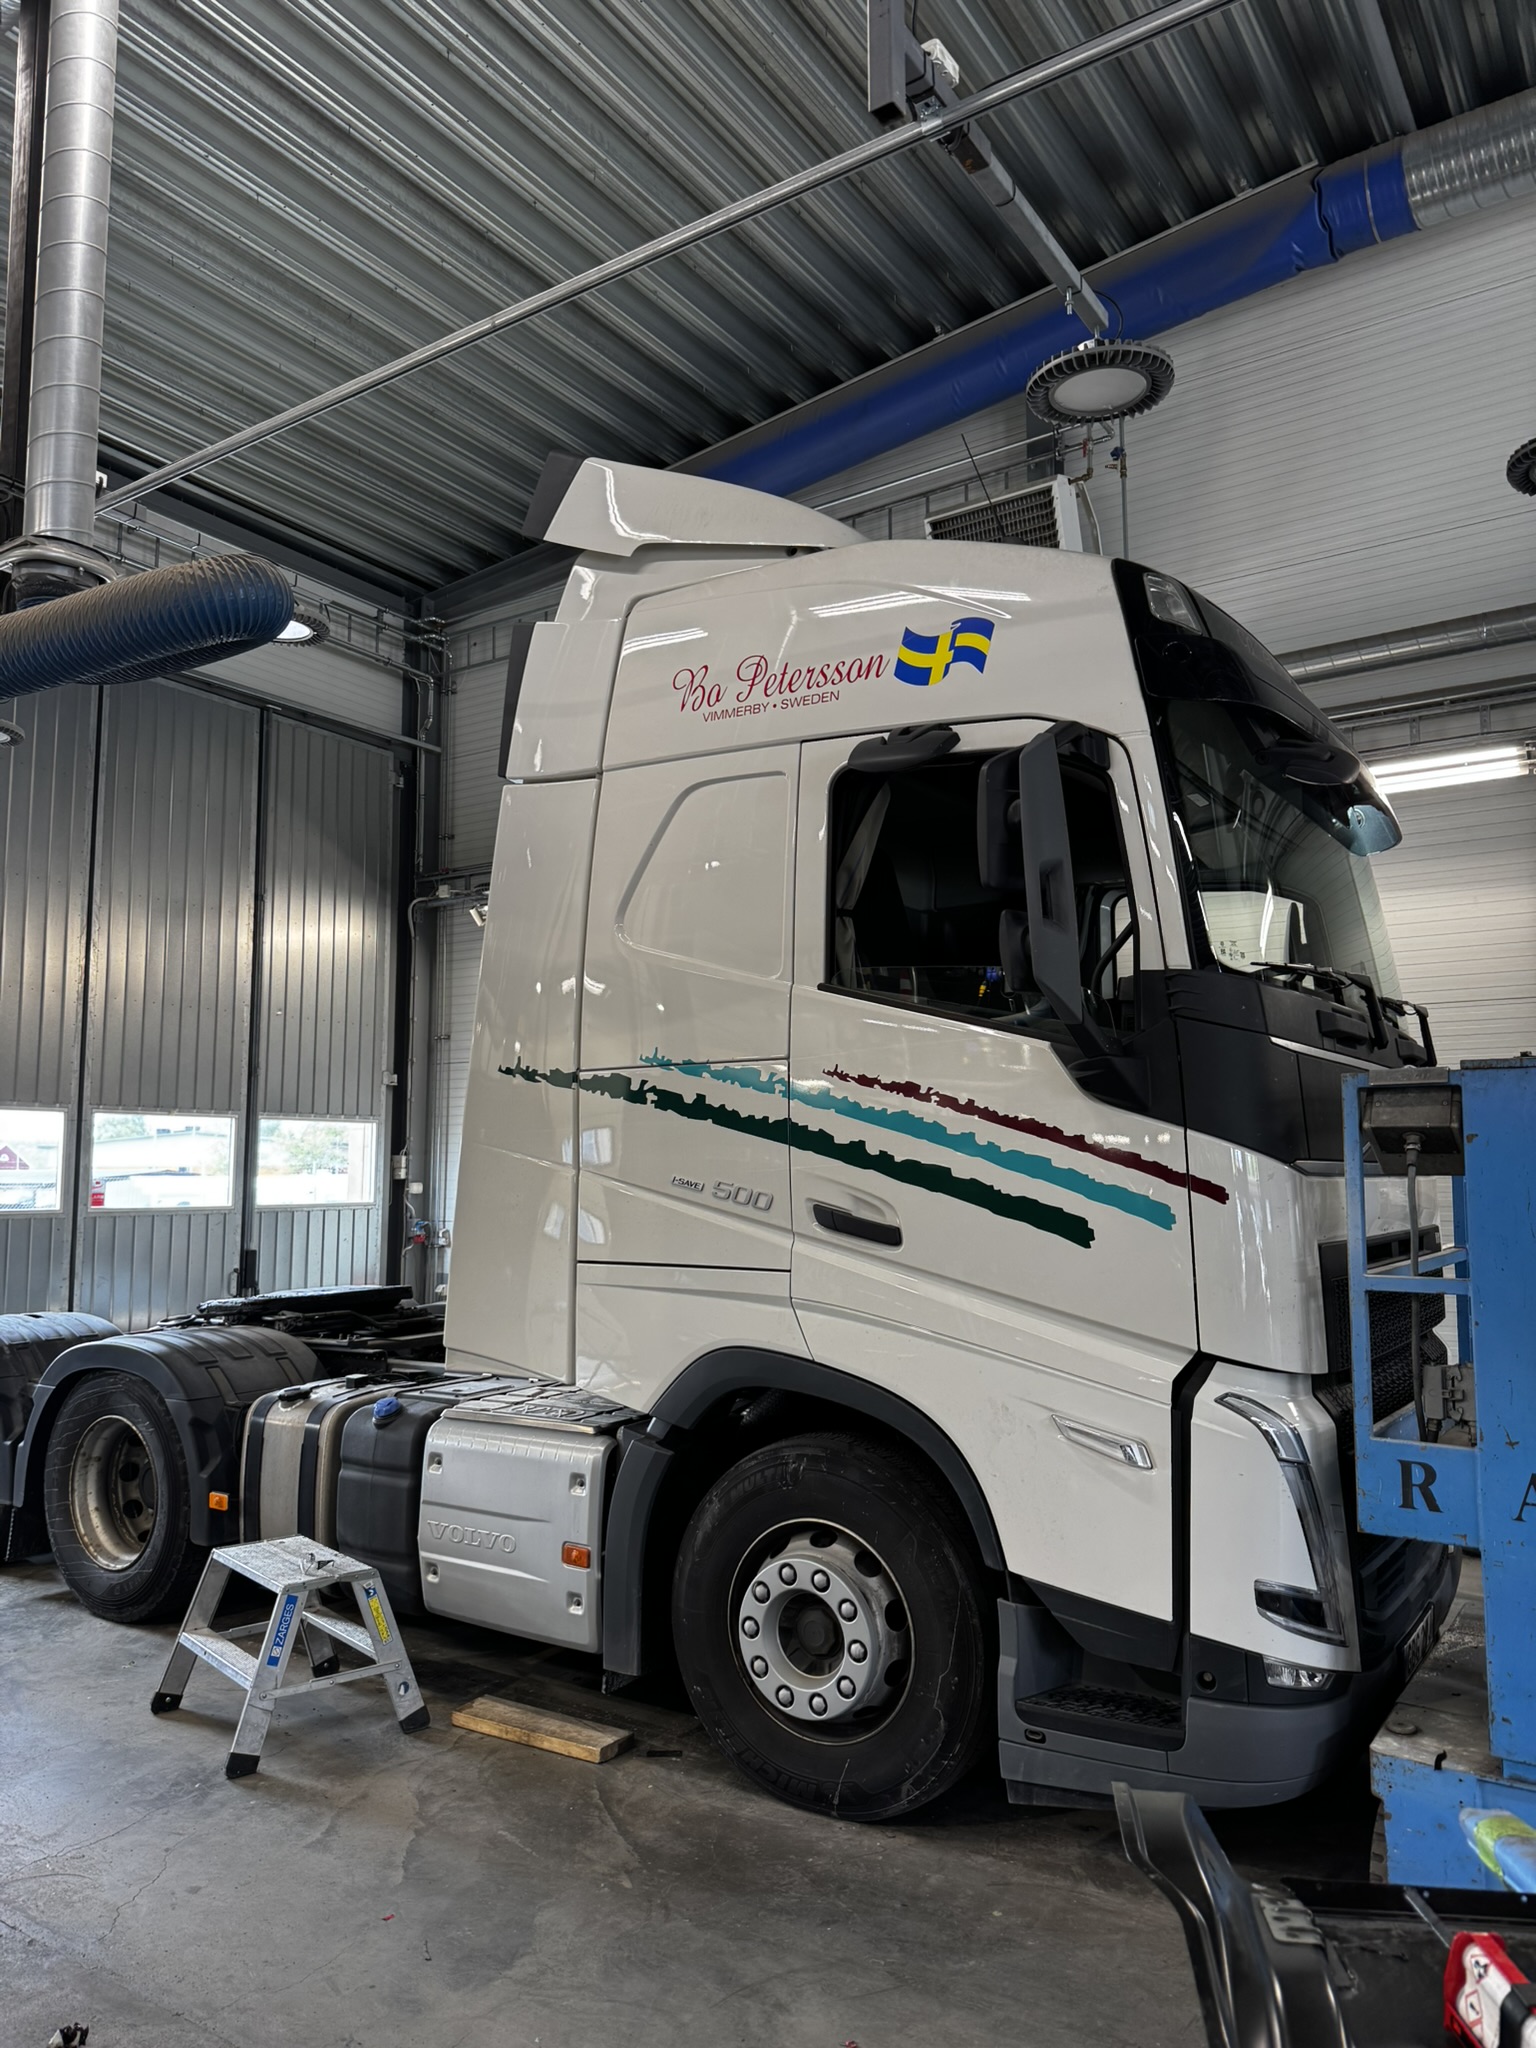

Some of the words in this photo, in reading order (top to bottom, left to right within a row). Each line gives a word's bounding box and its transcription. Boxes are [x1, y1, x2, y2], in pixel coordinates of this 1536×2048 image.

[673, 665, 726, 712] Bo
[736, 654, 890, 703] Petersson
[702, 702, 770, 723] VIMMERBY
[780, 690, 840, 710] SWEDEN
[672, 1176, 703, 1191] I-SAVE
[712, 1180, 774, 1212] 500
[1397, 1459, 1444, 1513] R
[427, 1520, 516, 1554] VOLVO
[275, 1603, 295, 1645] ZARGES
